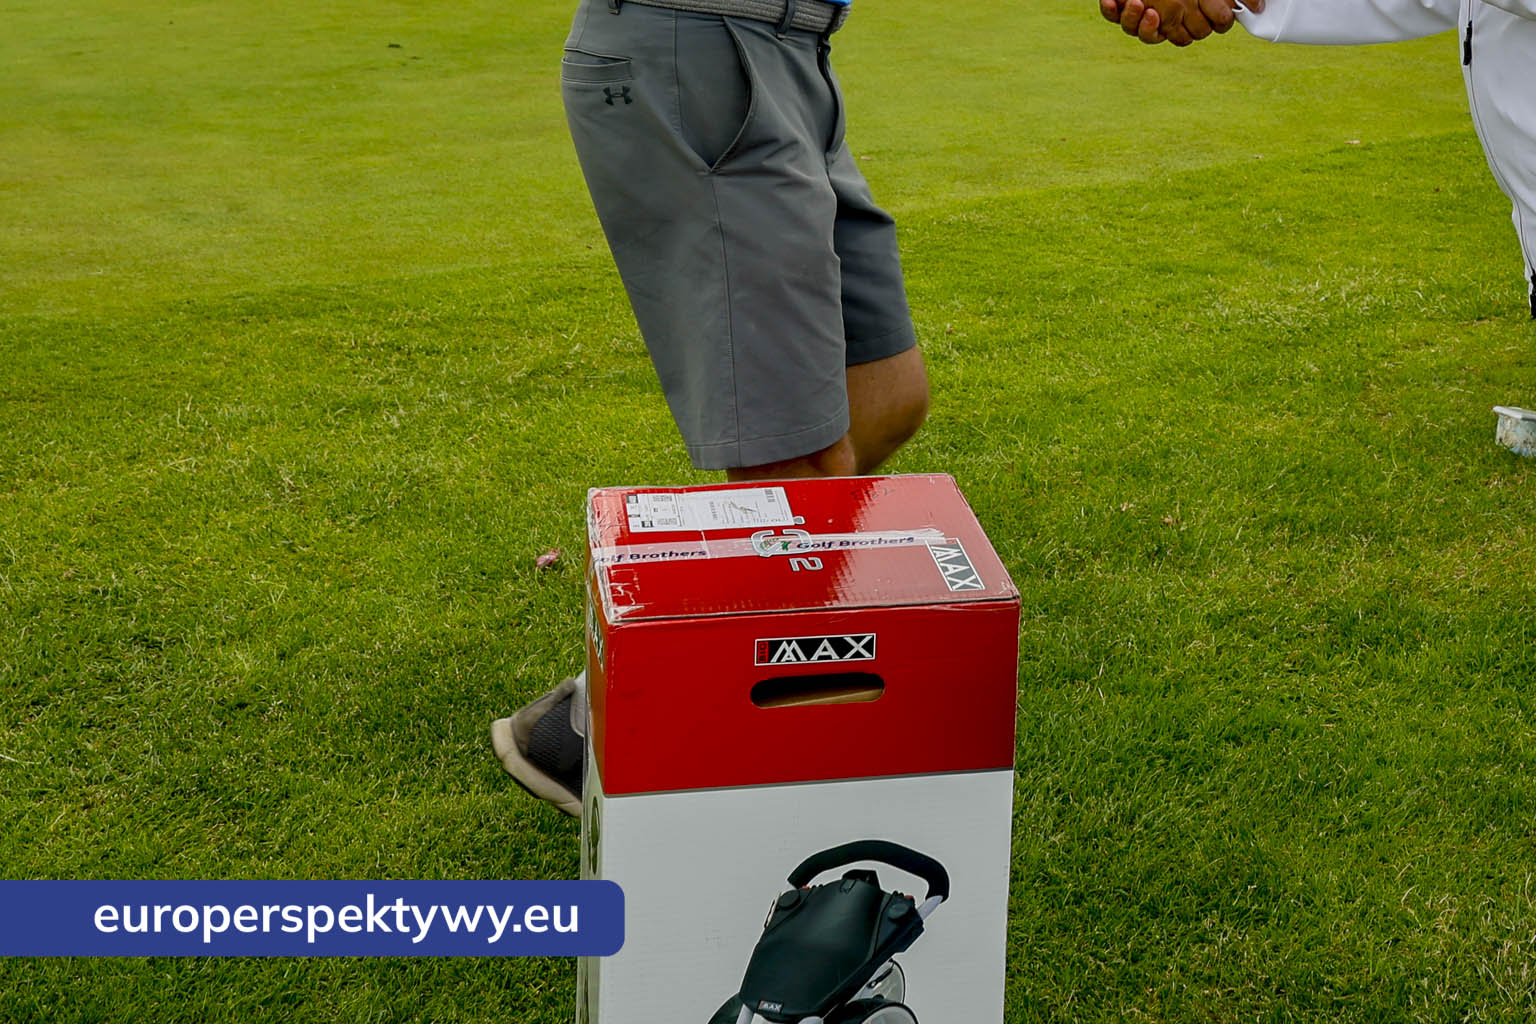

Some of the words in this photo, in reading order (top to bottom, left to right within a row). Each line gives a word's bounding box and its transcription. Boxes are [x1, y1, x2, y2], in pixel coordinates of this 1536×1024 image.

[839, 536, 914, 548] Brothers
[630, 549, 708, 561] Brothers
[769, 635, 874, 664] MAX
